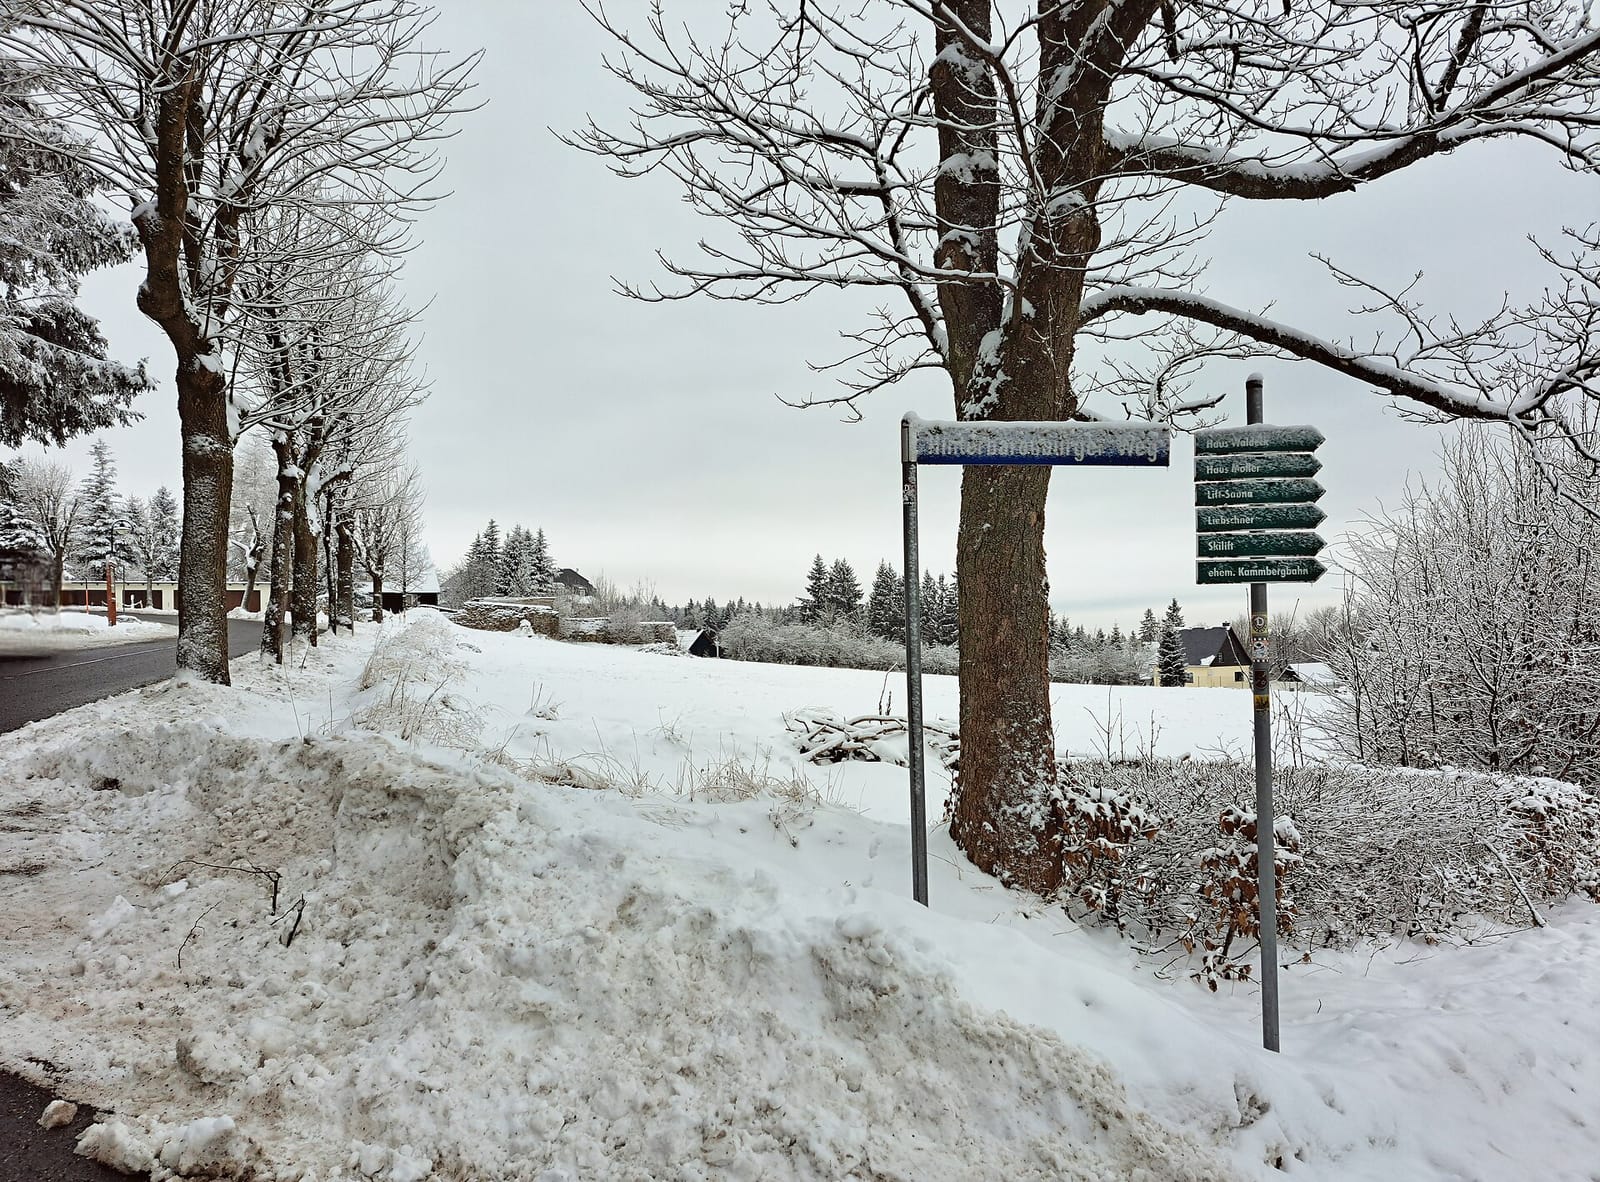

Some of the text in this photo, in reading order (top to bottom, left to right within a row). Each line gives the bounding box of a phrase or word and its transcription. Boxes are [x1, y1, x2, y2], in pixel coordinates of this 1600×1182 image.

[1206, 439, 1229, 449] Haus
[1206, 465, 1229, 474] Haus
[1207, 490, 1253, 499] Lift-Sauna
[1208, 516, 1254, 525] Liebschner
[1208, 541, 1234, 551] Skilift
[1208, 566, 1309, 578] ehem. Kammbergbahn
